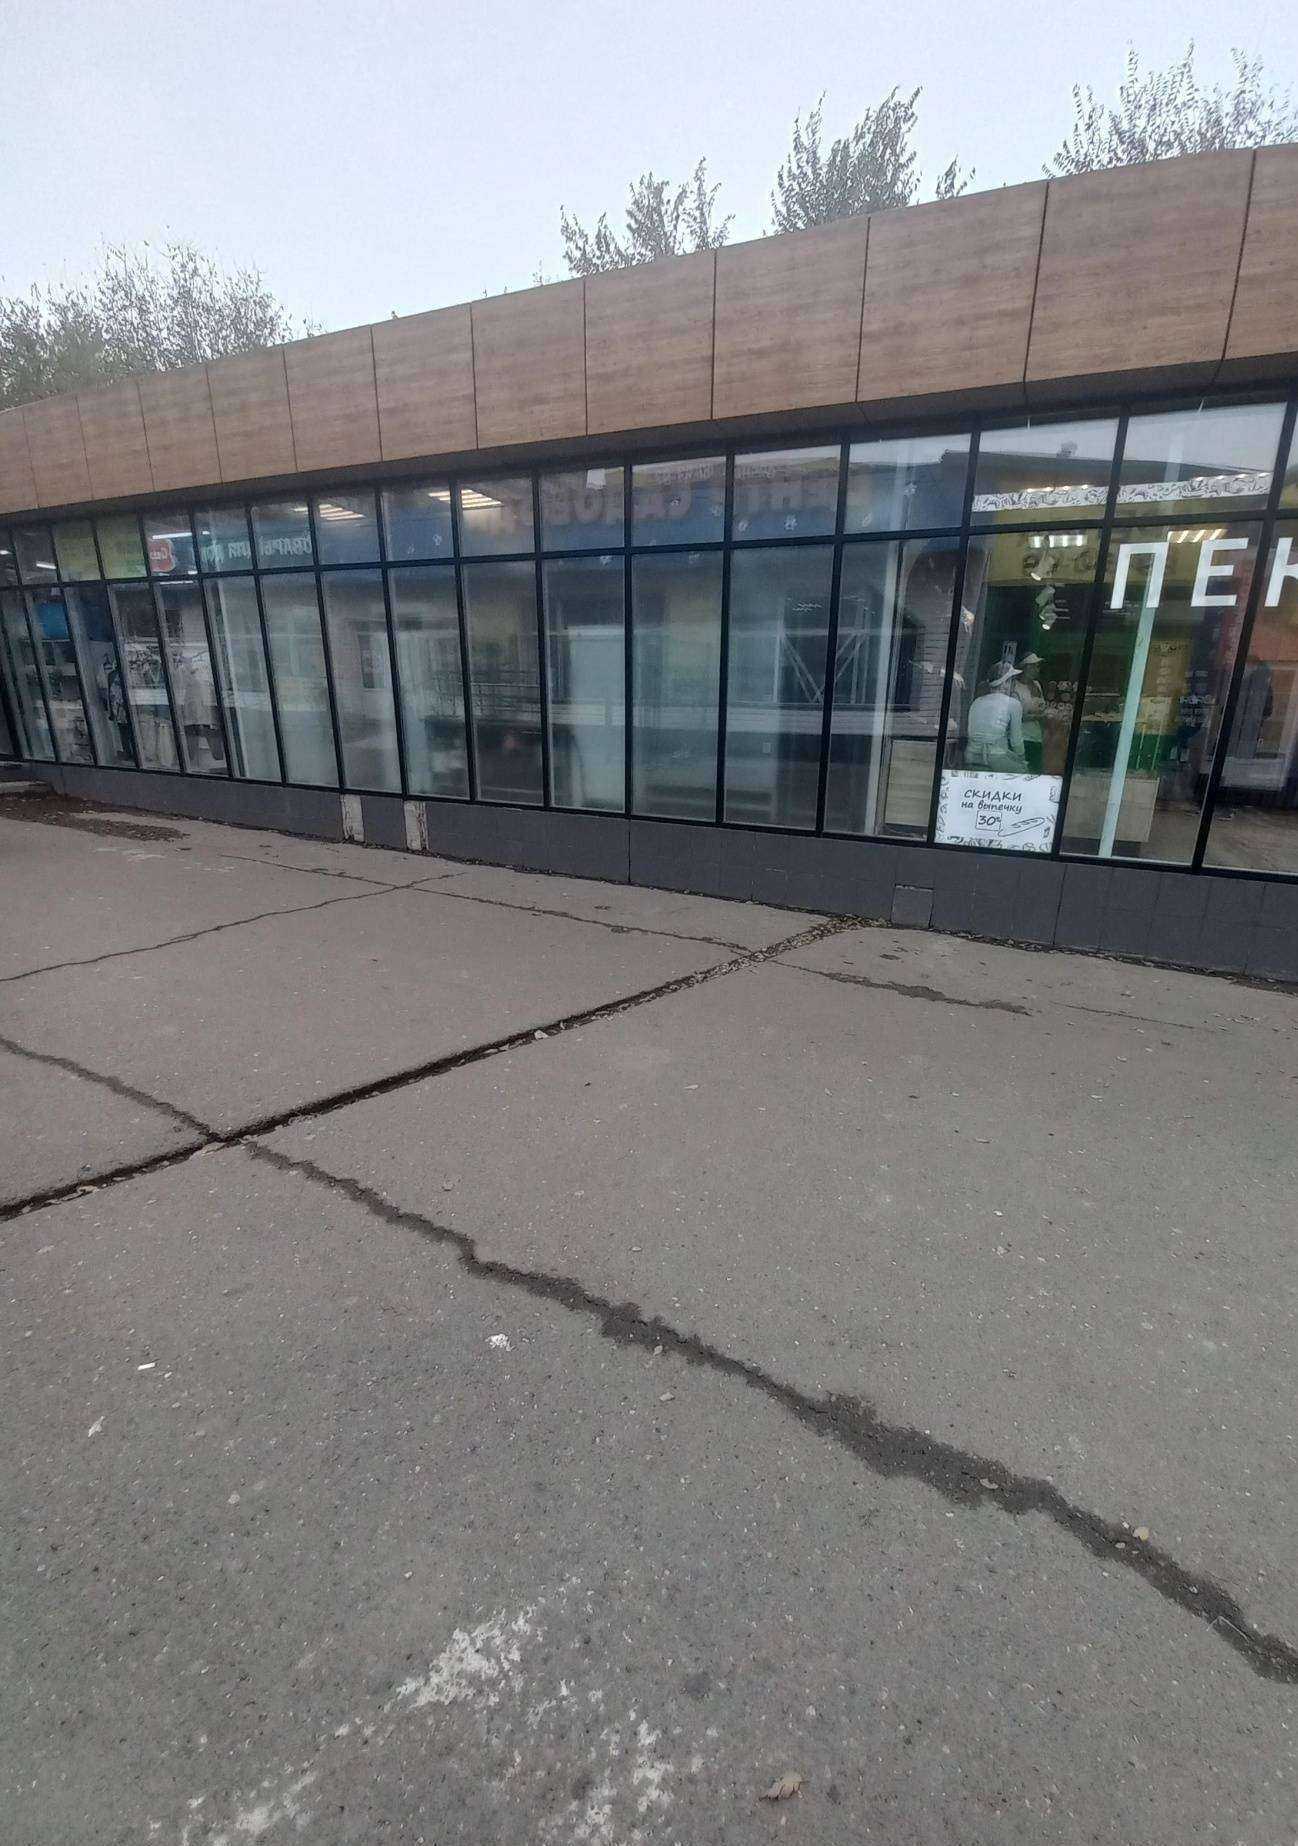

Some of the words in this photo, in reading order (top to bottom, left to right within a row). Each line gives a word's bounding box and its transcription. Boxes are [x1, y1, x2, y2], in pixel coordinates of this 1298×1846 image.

[964, 789, 1022, 801] СКИДКИ
[961, 800, 974, 809] на
[978, 799, 1023, 814] выпечку
